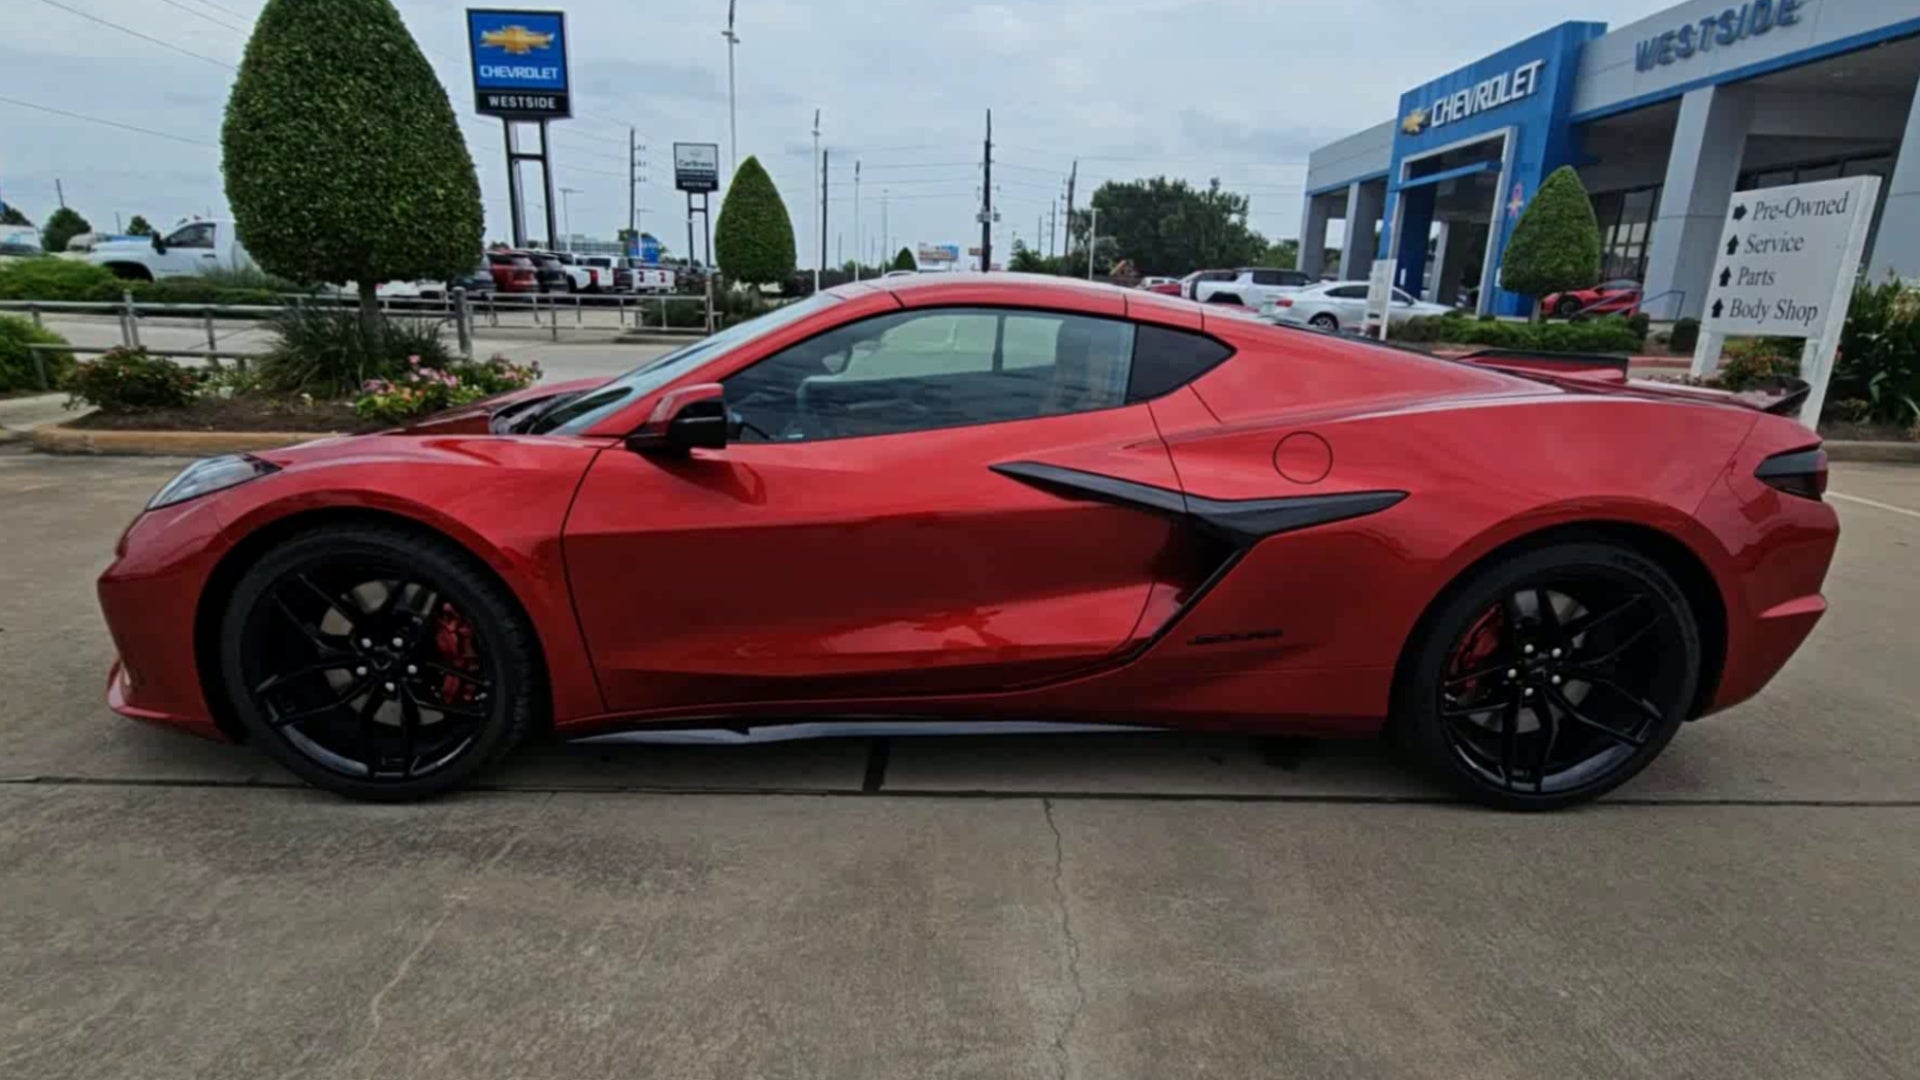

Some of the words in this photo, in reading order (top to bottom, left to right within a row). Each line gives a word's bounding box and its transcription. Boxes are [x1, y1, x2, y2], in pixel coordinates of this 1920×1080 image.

[1635, 0, 1801, 73] WESTSIDE
[480, 65, 558, 80] CHEVROLET
[488, 95, 556, 109] WESTSIDE
[1431, 58, 1545, 127] CHEVROLET
[1753, 191, 1849, 221] Pre-Owned
[1744, 232, 1804, 254] Service
[1737, 266, 1776, 286] Parts
[1729, 298, 1770, 324] Body
[1774, 298, 1818, 327] Shop
